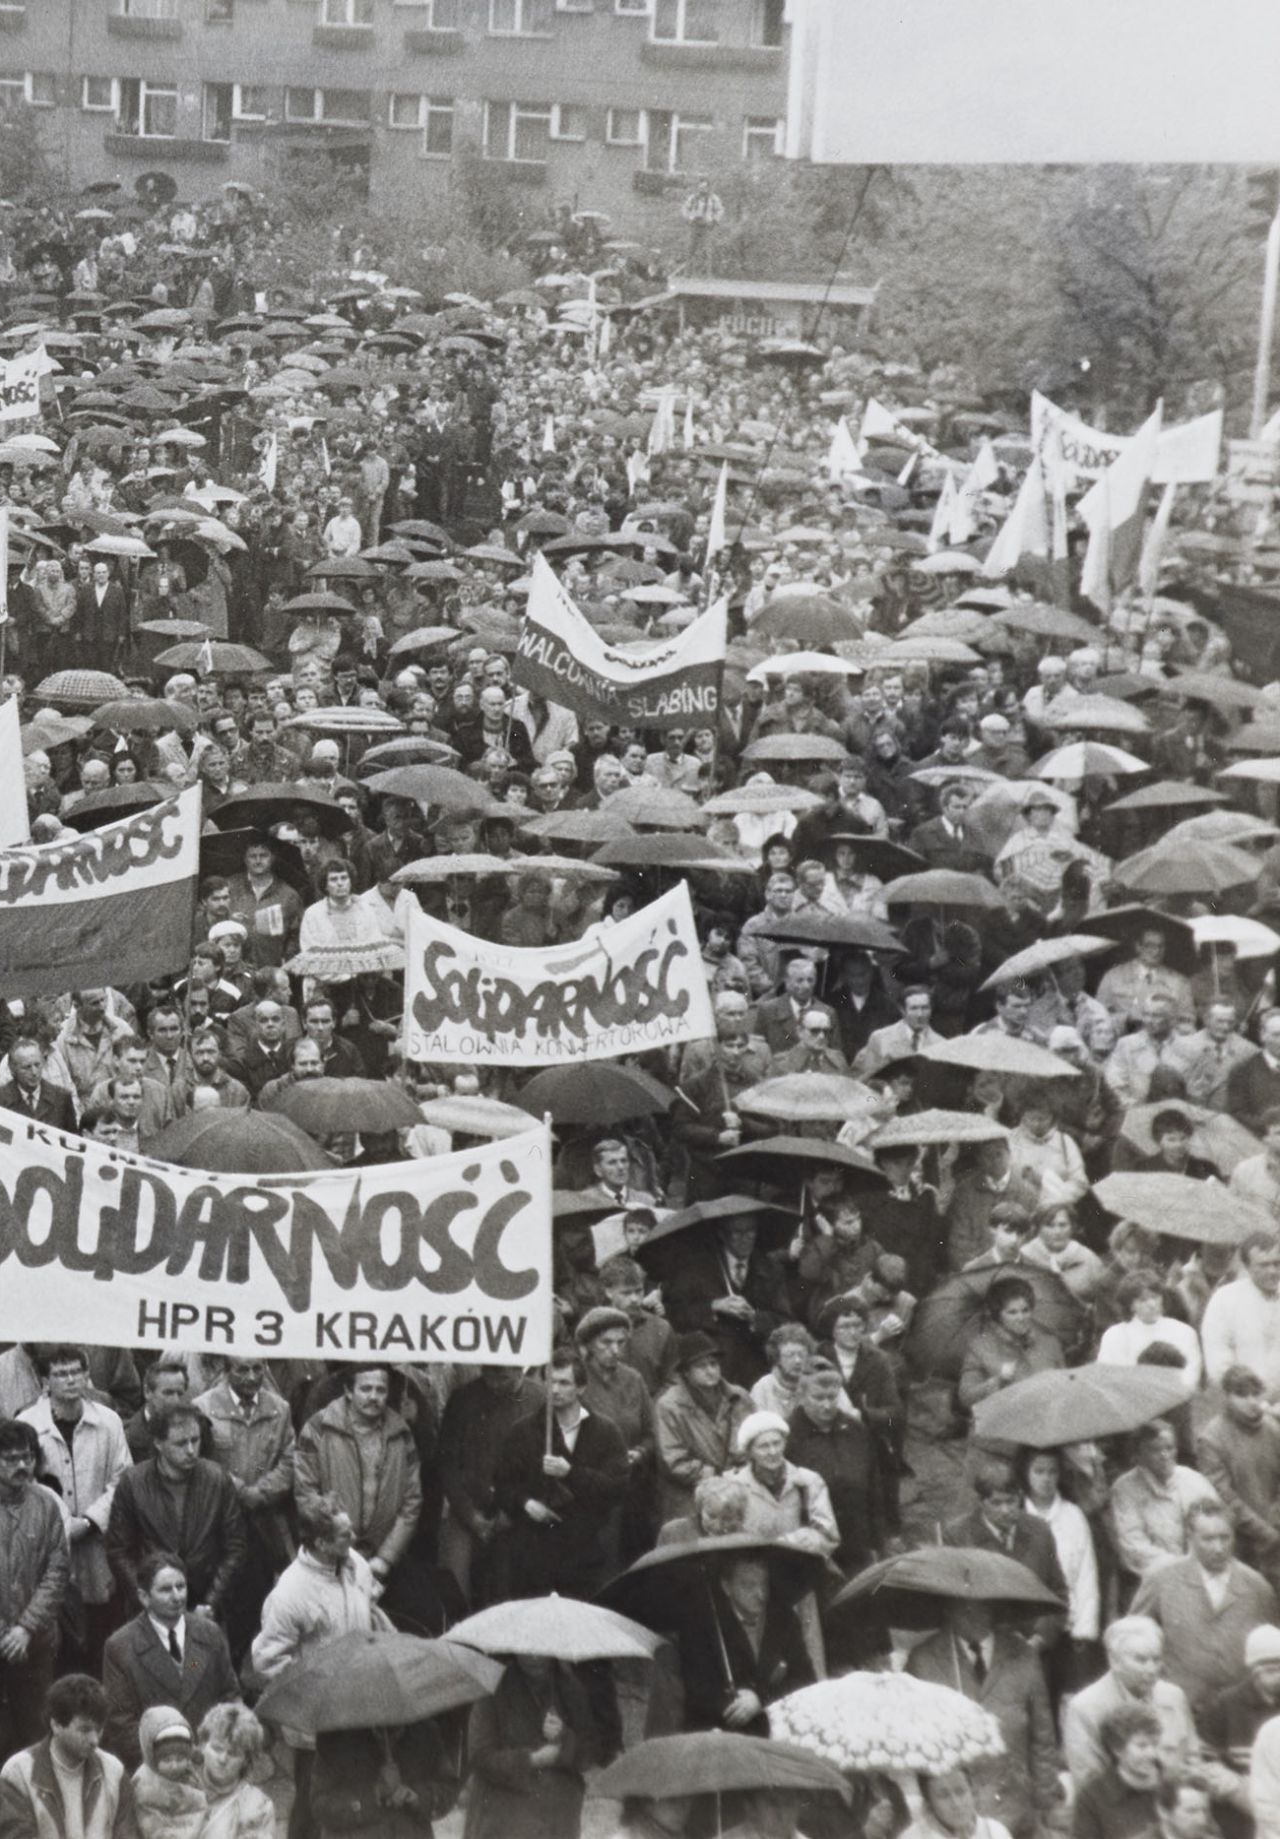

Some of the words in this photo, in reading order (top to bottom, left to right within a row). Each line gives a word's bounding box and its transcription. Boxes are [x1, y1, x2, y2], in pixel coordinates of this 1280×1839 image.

[136, 1298, 236, 1345] HPR
[254, 1308, 285, 1347] 3
[315, 1304, 529, 1355] KRAKÓW
